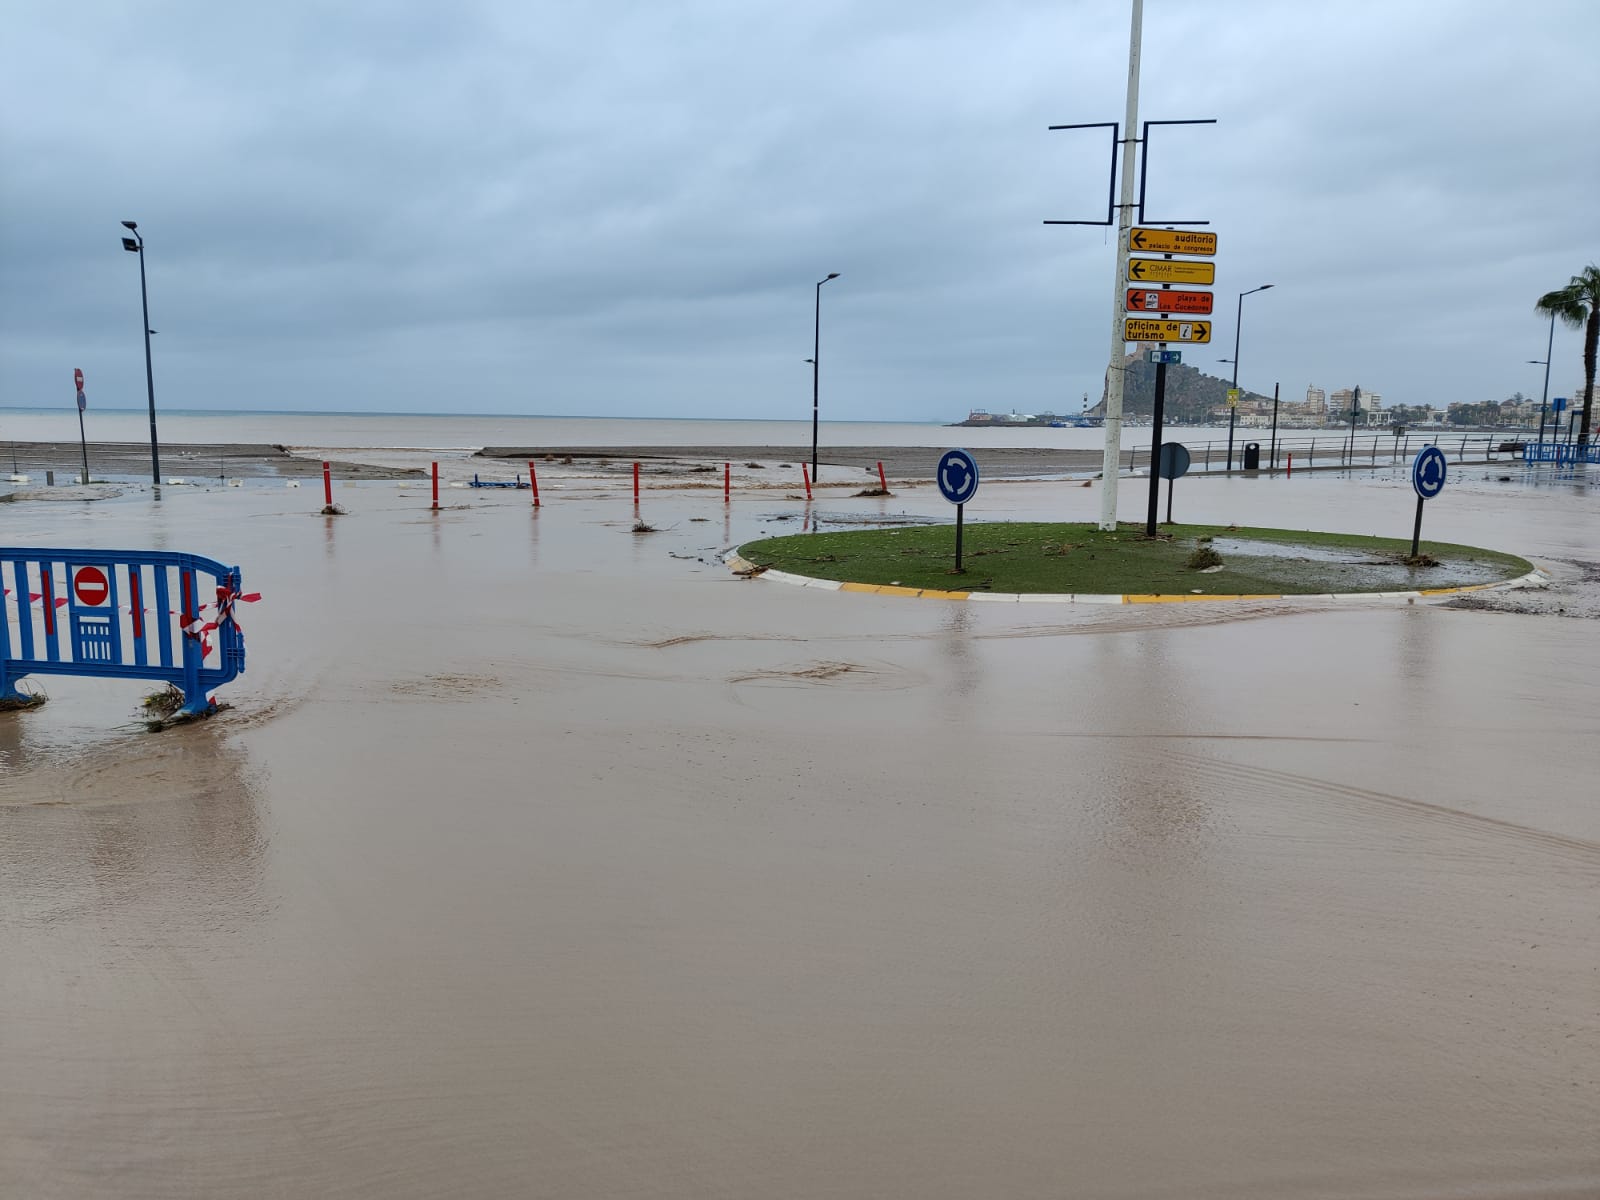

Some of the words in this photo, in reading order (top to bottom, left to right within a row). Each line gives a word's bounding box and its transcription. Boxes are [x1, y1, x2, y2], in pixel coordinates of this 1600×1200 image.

[1175, 234, 1214, 244] auditorio
[1128, 321, 1160, 330] oficina
[1166, 322, 1178, 331] de
[1128, 331, 1164, 340] turismo
